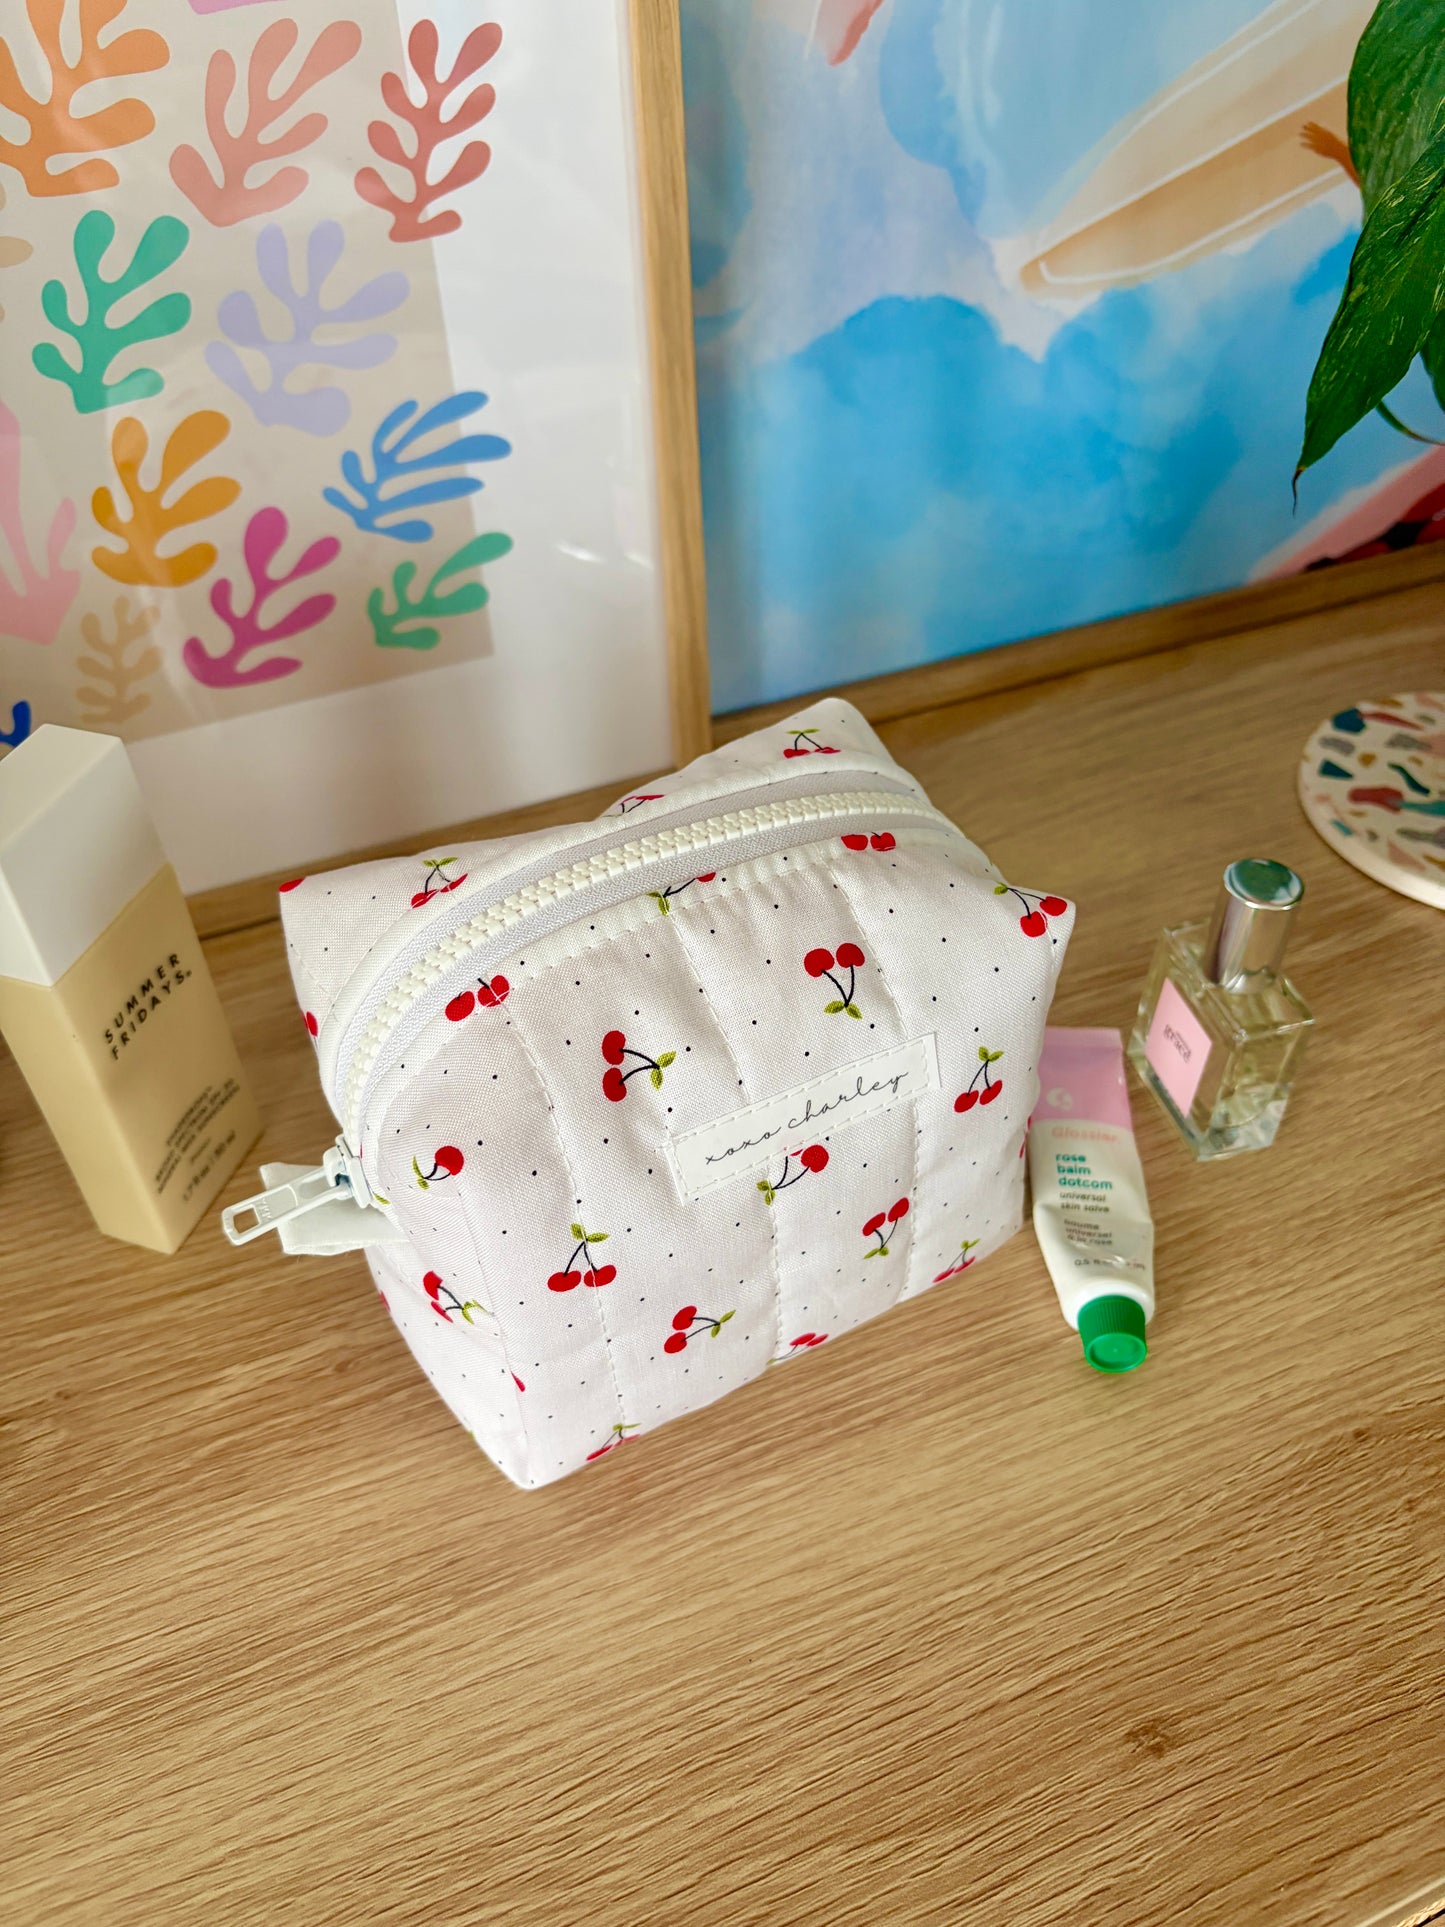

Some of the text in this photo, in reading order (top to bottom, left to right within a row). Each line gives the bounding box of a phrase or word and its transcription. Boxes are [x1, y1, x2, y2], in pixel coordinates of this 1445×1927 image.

[104, 953, 180, 1045] SUMMER
[705, 1071, 909, 1165] xoxo charley
[1055, 1153, 1086, 1163] rose
[1056, 1163, 1091, 1175] balm
[1058, 1176, 1113, 1190] dotcom
